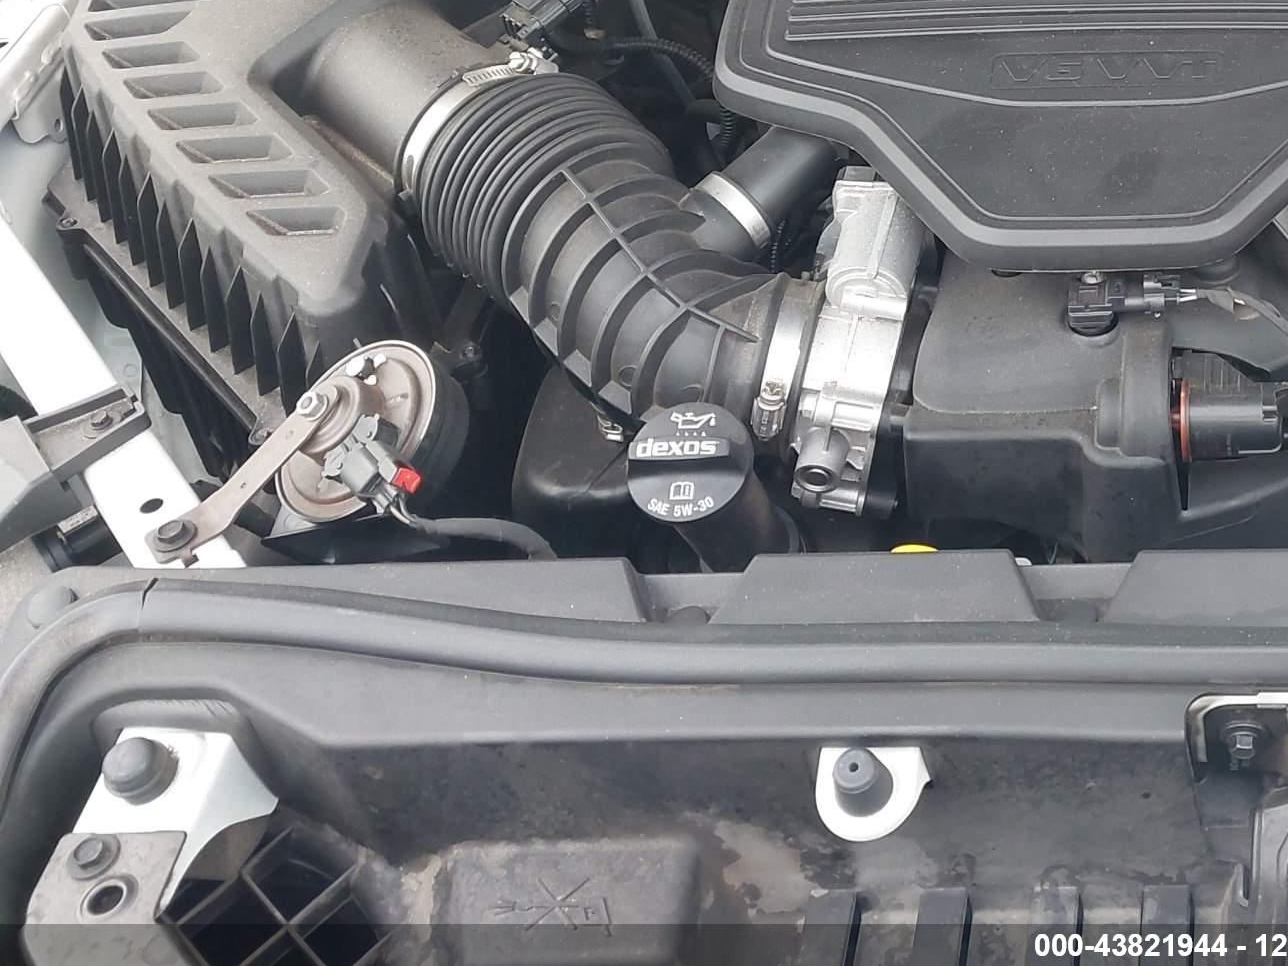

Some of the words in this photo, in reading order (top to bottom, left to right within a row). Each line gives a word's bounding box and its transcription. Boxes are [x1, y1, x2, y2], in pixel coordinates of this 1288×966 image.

[636, 438, 720, 458] dexos
[647, 498, 670, 516] SAE
[673, 496, 714, 517] 5W-30
